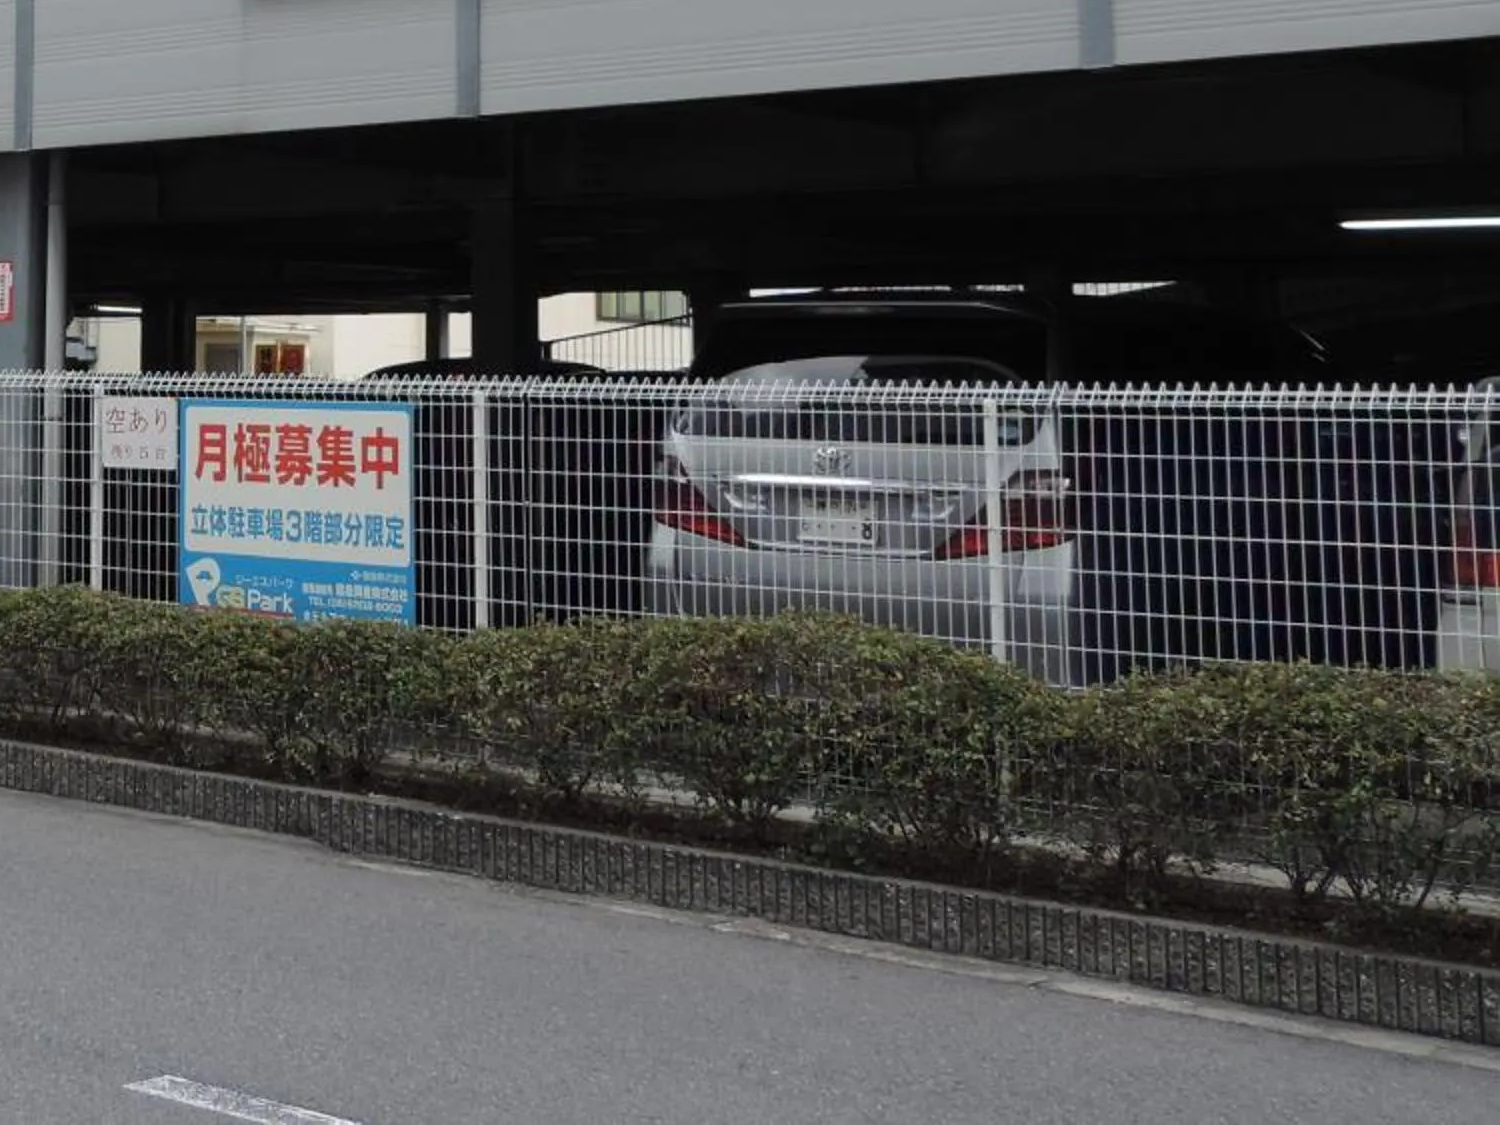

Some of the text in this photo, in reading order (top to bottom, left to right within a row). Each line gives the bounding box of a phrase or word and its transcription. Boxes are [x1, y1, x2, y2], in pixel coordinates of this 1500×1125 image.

[196, 423, 400, 489] 月極募集中
